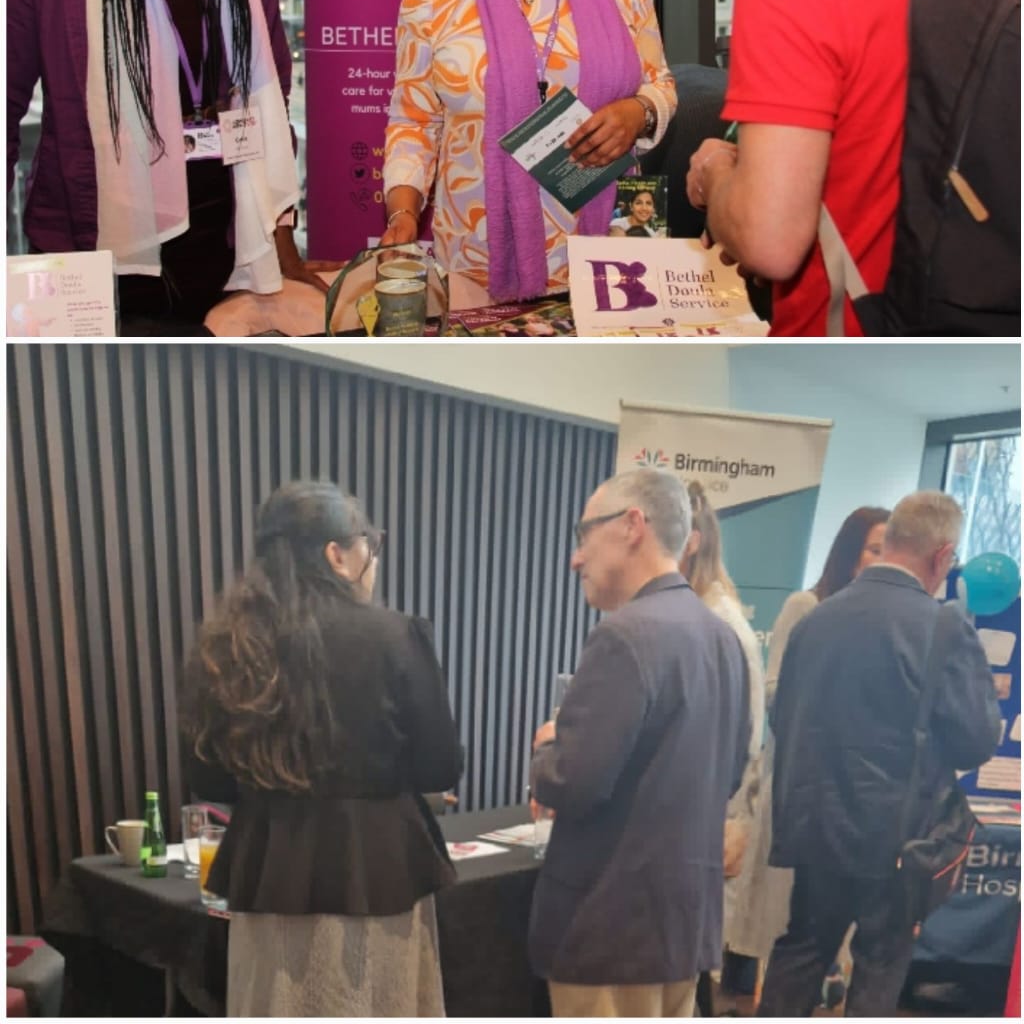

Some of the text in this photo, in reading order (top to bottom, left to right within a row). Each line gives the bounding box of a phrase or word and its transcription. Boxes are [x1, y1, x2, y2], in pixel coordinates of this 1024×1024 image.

[347, 67, 391, 79] 24-hour
[341, 87, 366, 96] care
[368, 85, 384, 96] for
[350, 104, 382, 114] mums
[664, 269, 716, 284] Bethel
[667, 284, 715, 298] Doula
[668, 297, 730, 310] Service
[673, 453, 776, 480] Birmingham
